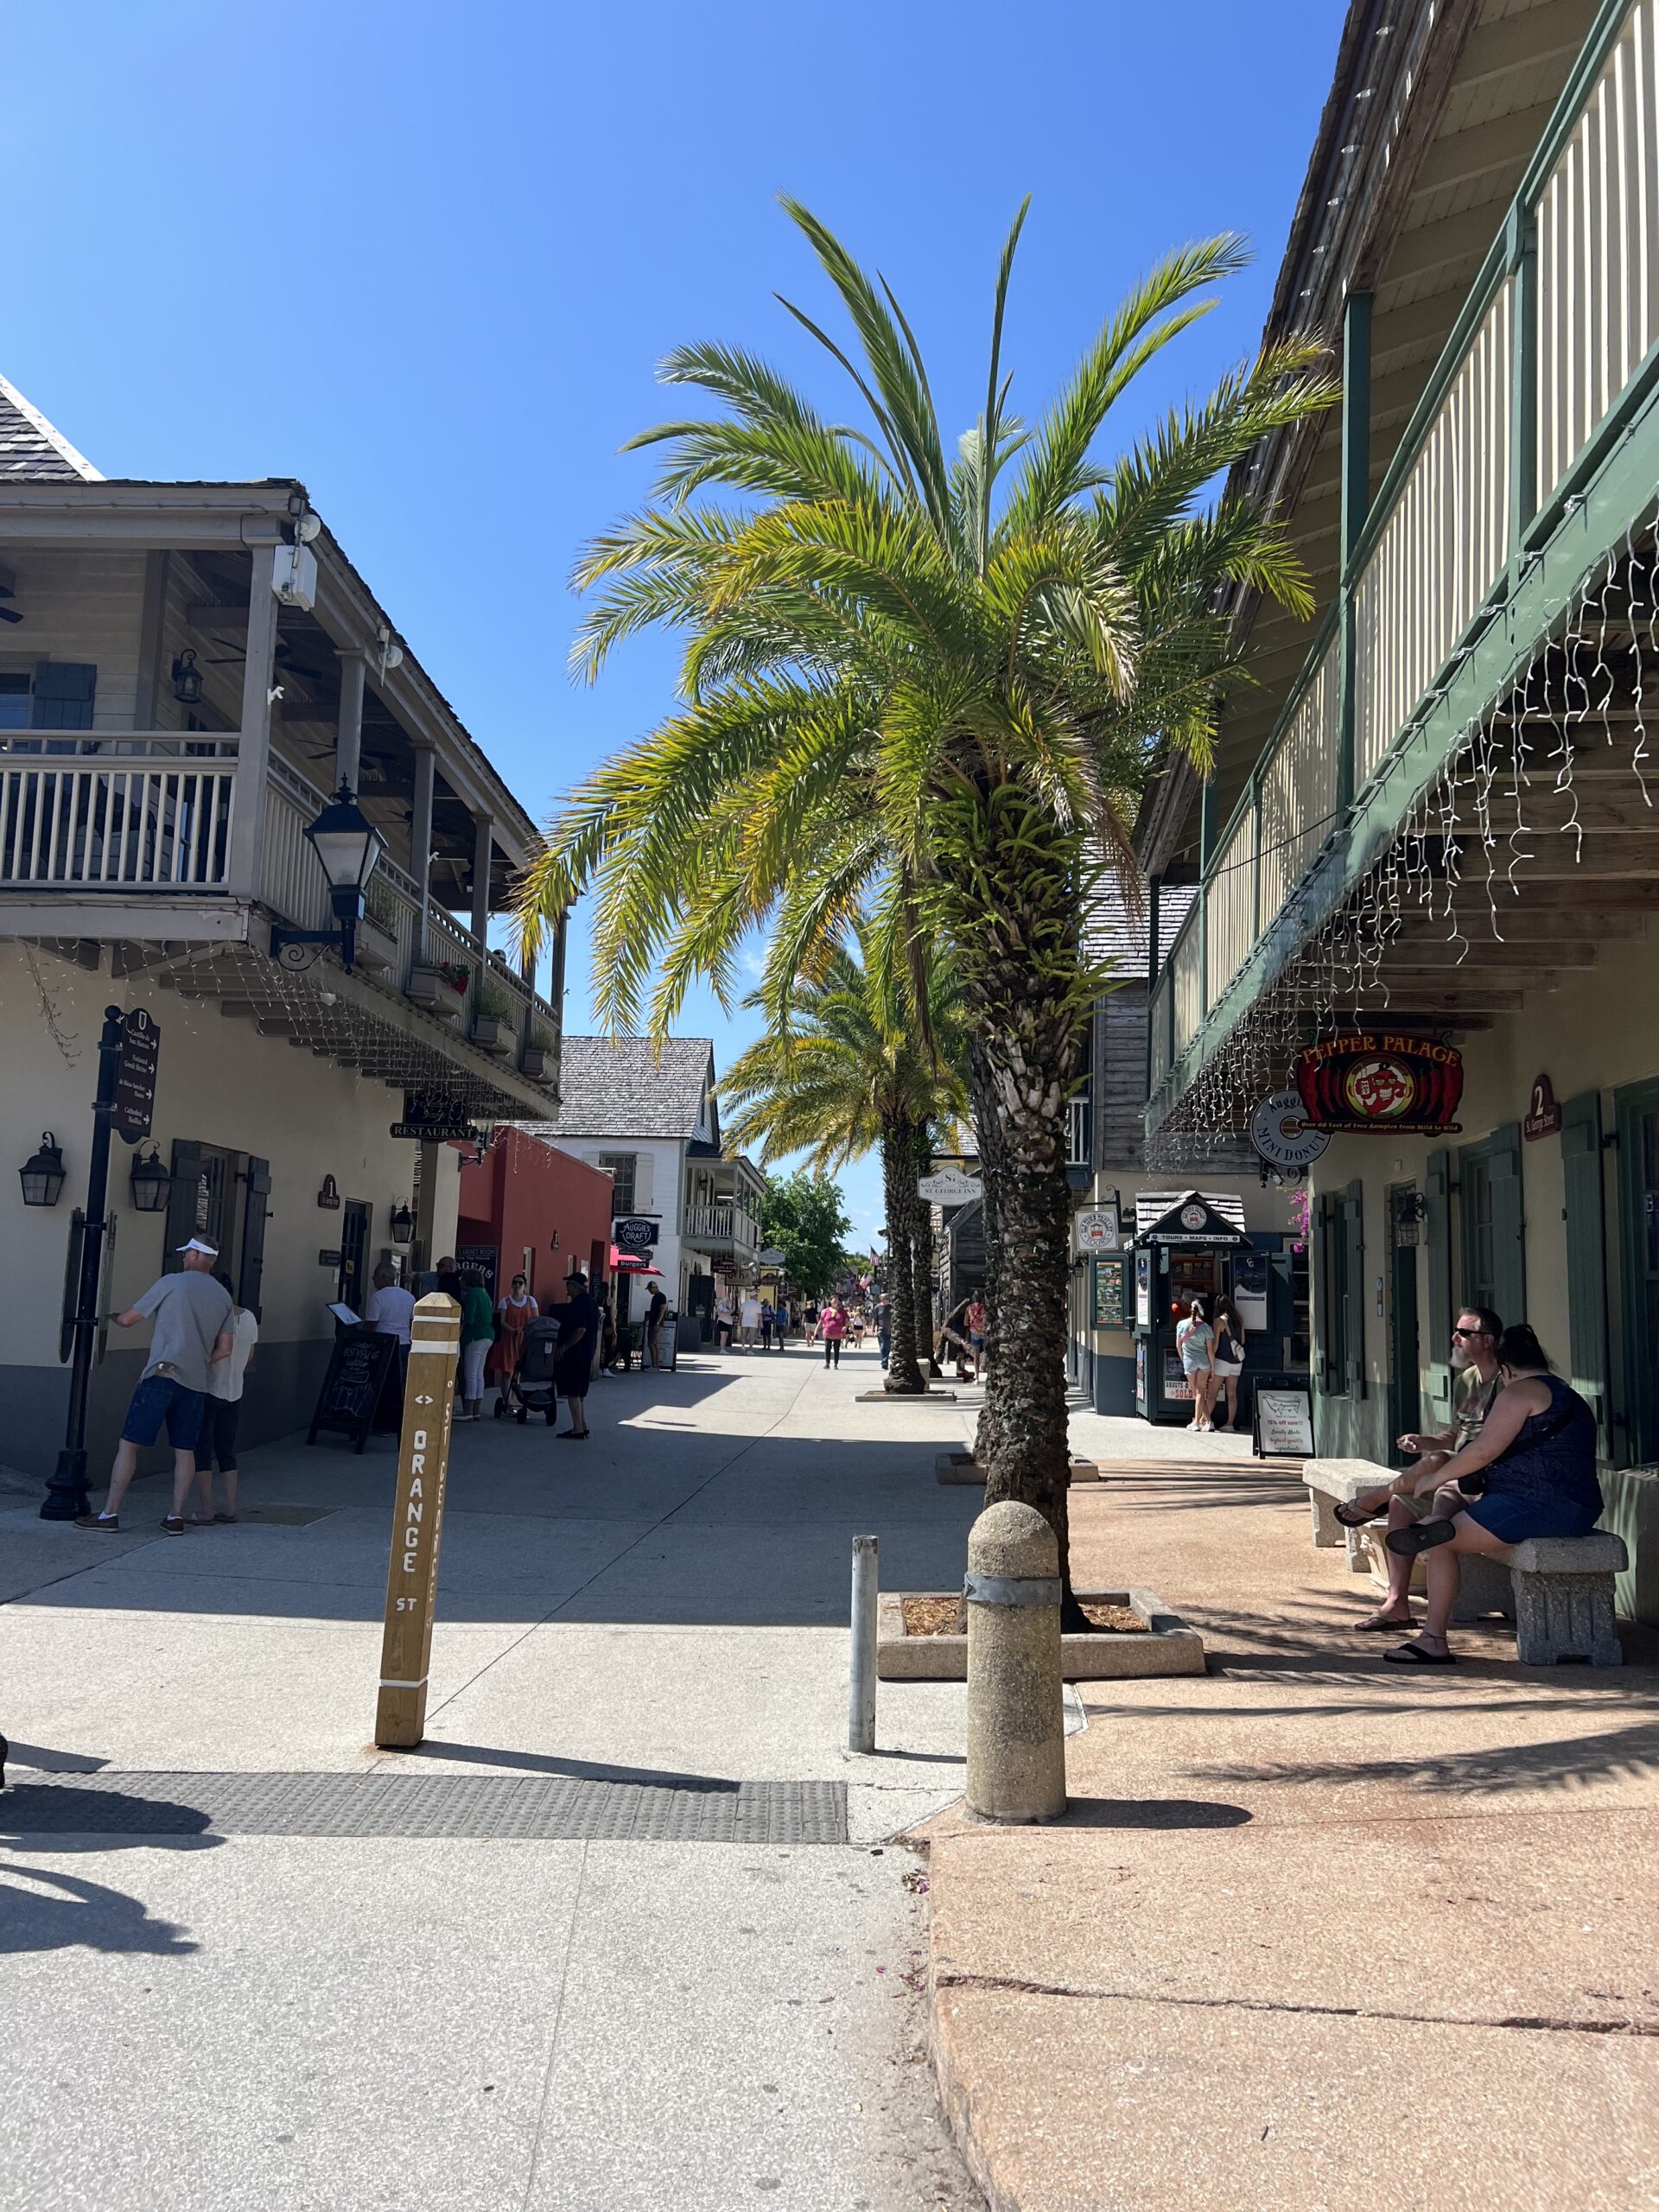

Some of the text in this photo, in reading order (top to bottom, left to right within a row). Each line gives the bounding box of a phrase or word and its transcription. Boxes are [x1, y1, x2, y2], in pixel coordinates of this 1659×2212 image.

[1301, 1037, 1376, 1065] PEPPER
[1268, 1096, 1301, 1113] Auggi
[1535, 1086, 1544, 1116] 2
[394, 1126, 473, 1138] RESTAURANT
[1257, 1127, 1325, 1161] MINI DONUT
[328, 1181, 334, 1198] 1
[621, 1223, 651, 1232] AUGGIE'S
[626, 1232, 648, 1242] DRAFT
[1175, 1389, 1193, 1398] SOLD
[396, 1430, 428, 1611] ORANGE ST
